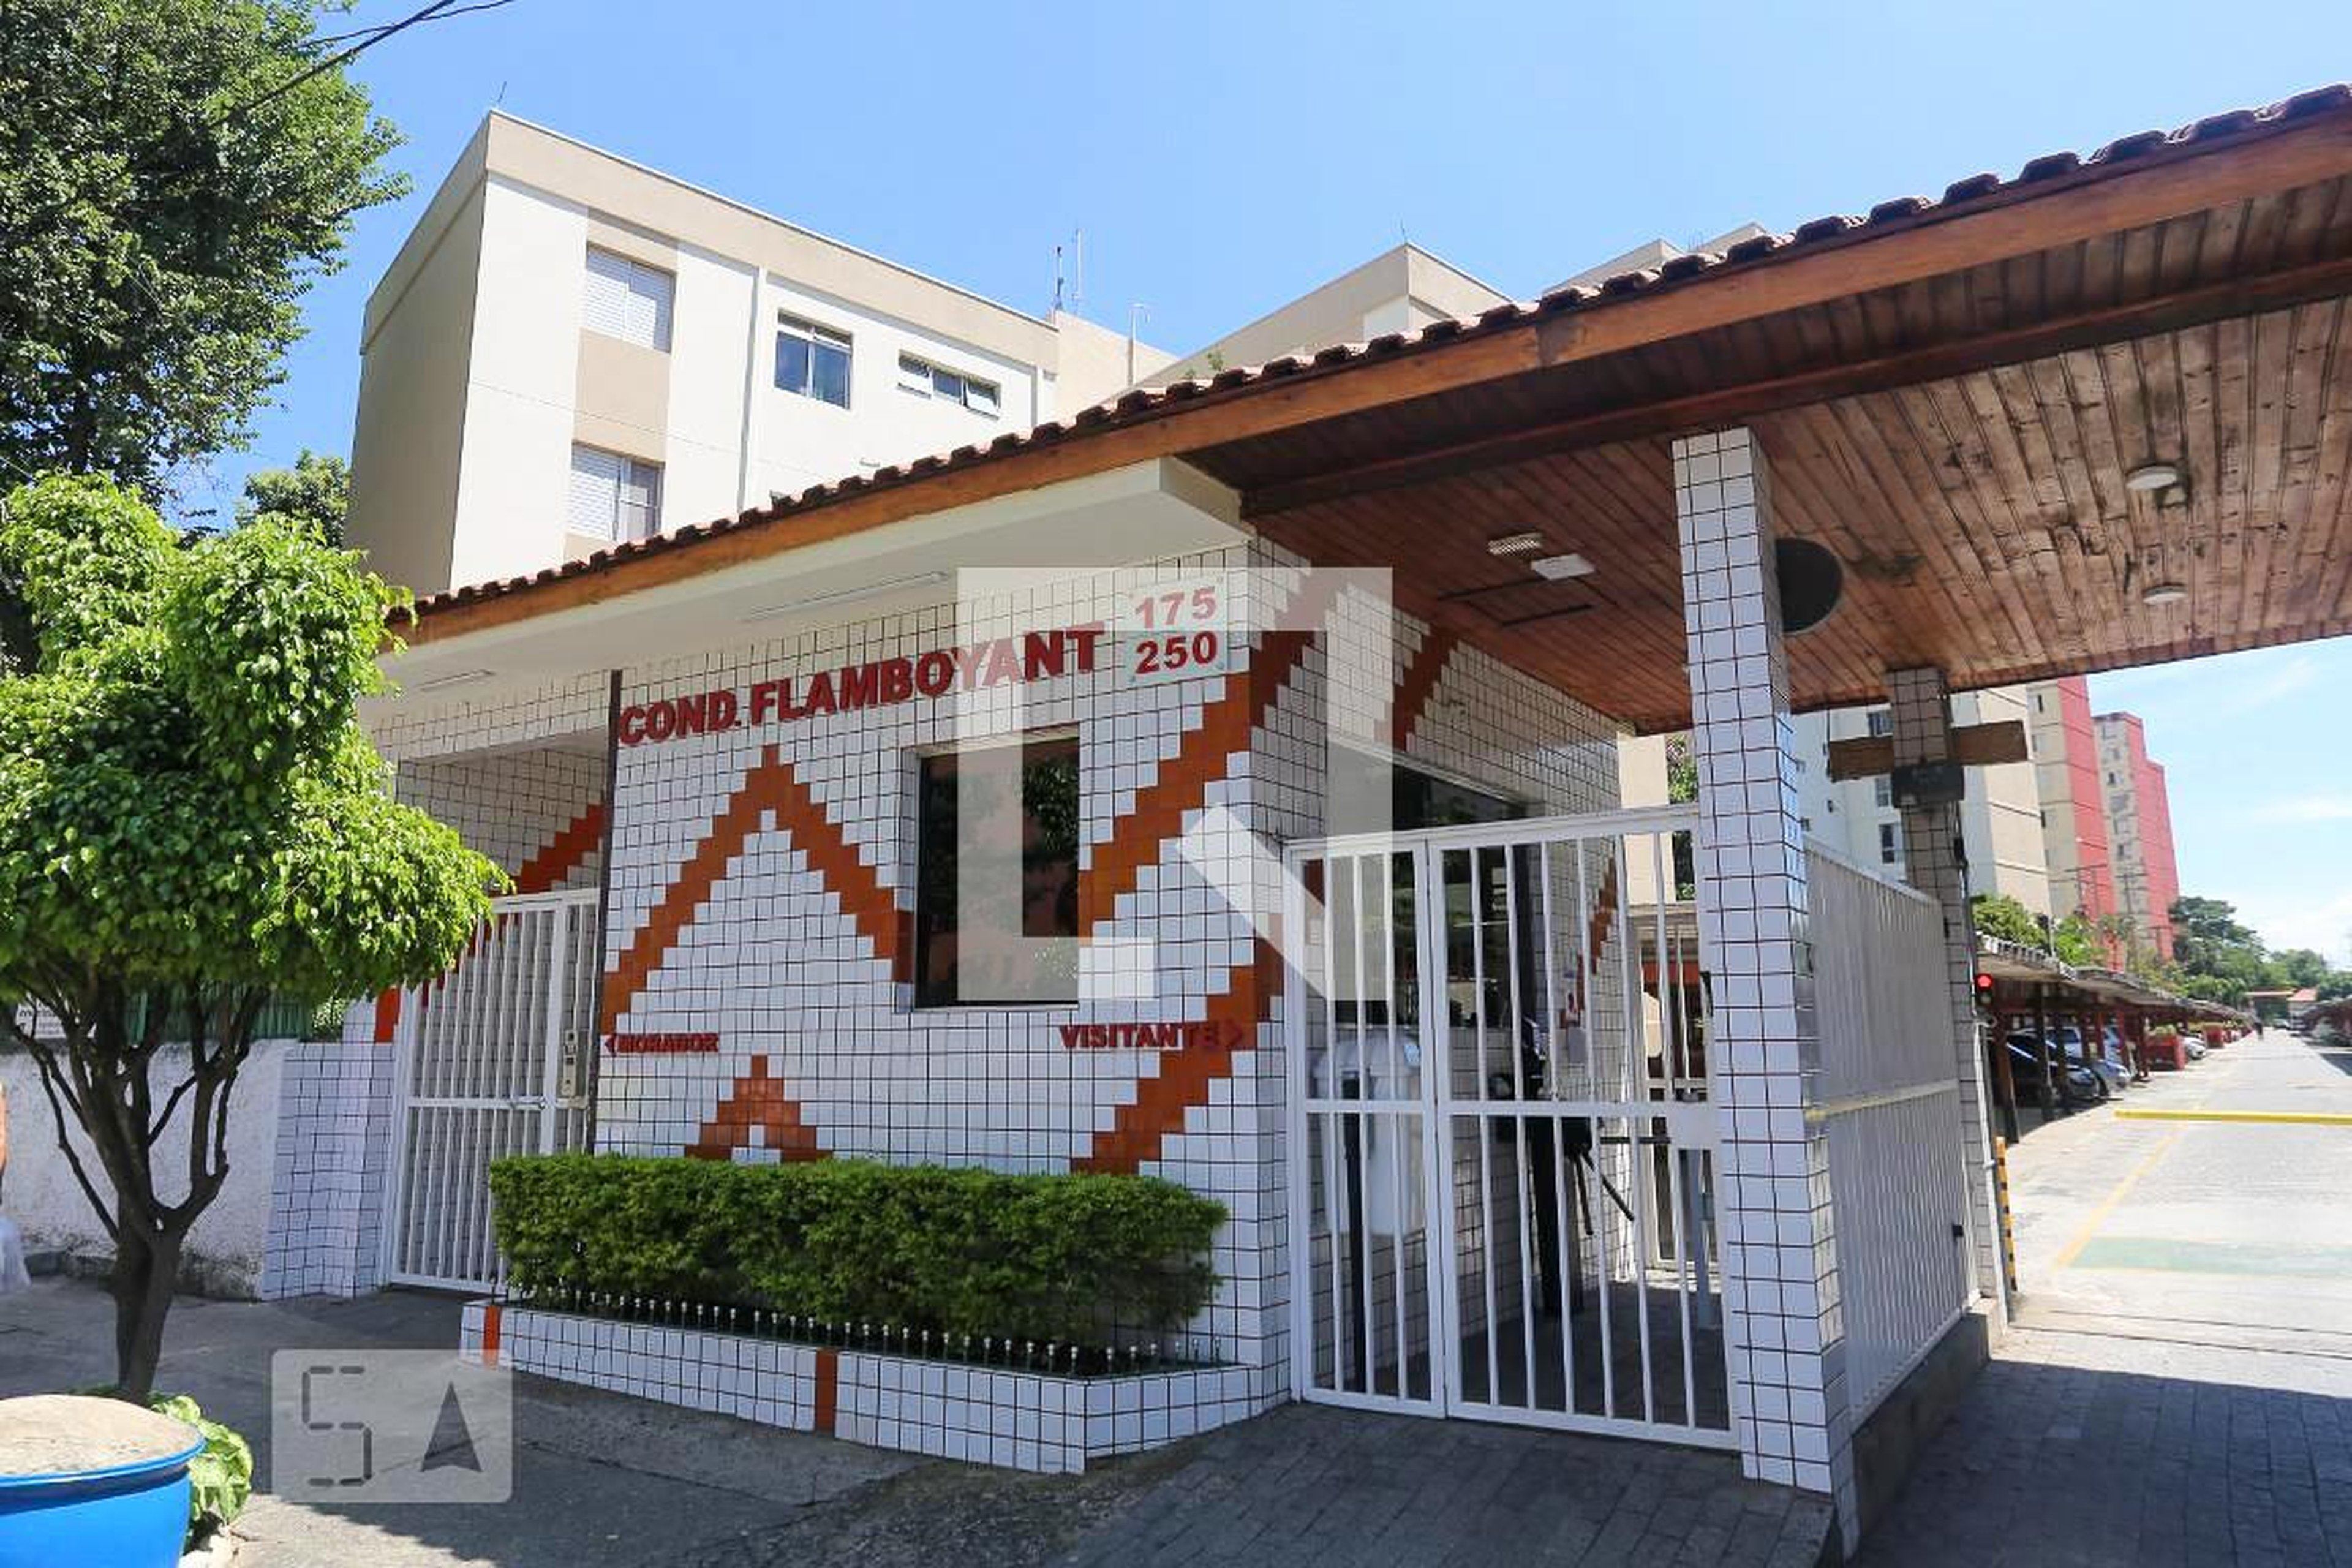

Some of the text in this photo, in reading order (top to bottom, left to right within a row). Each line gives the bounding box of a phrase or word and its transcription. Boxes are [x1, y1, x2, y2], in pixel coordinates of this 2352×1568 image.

[1136, 586, 1217, 628] 175
[1136, 631, 1218, 674] 250
[619, 620, 1105, 745] COND. FLAMBOYANT
